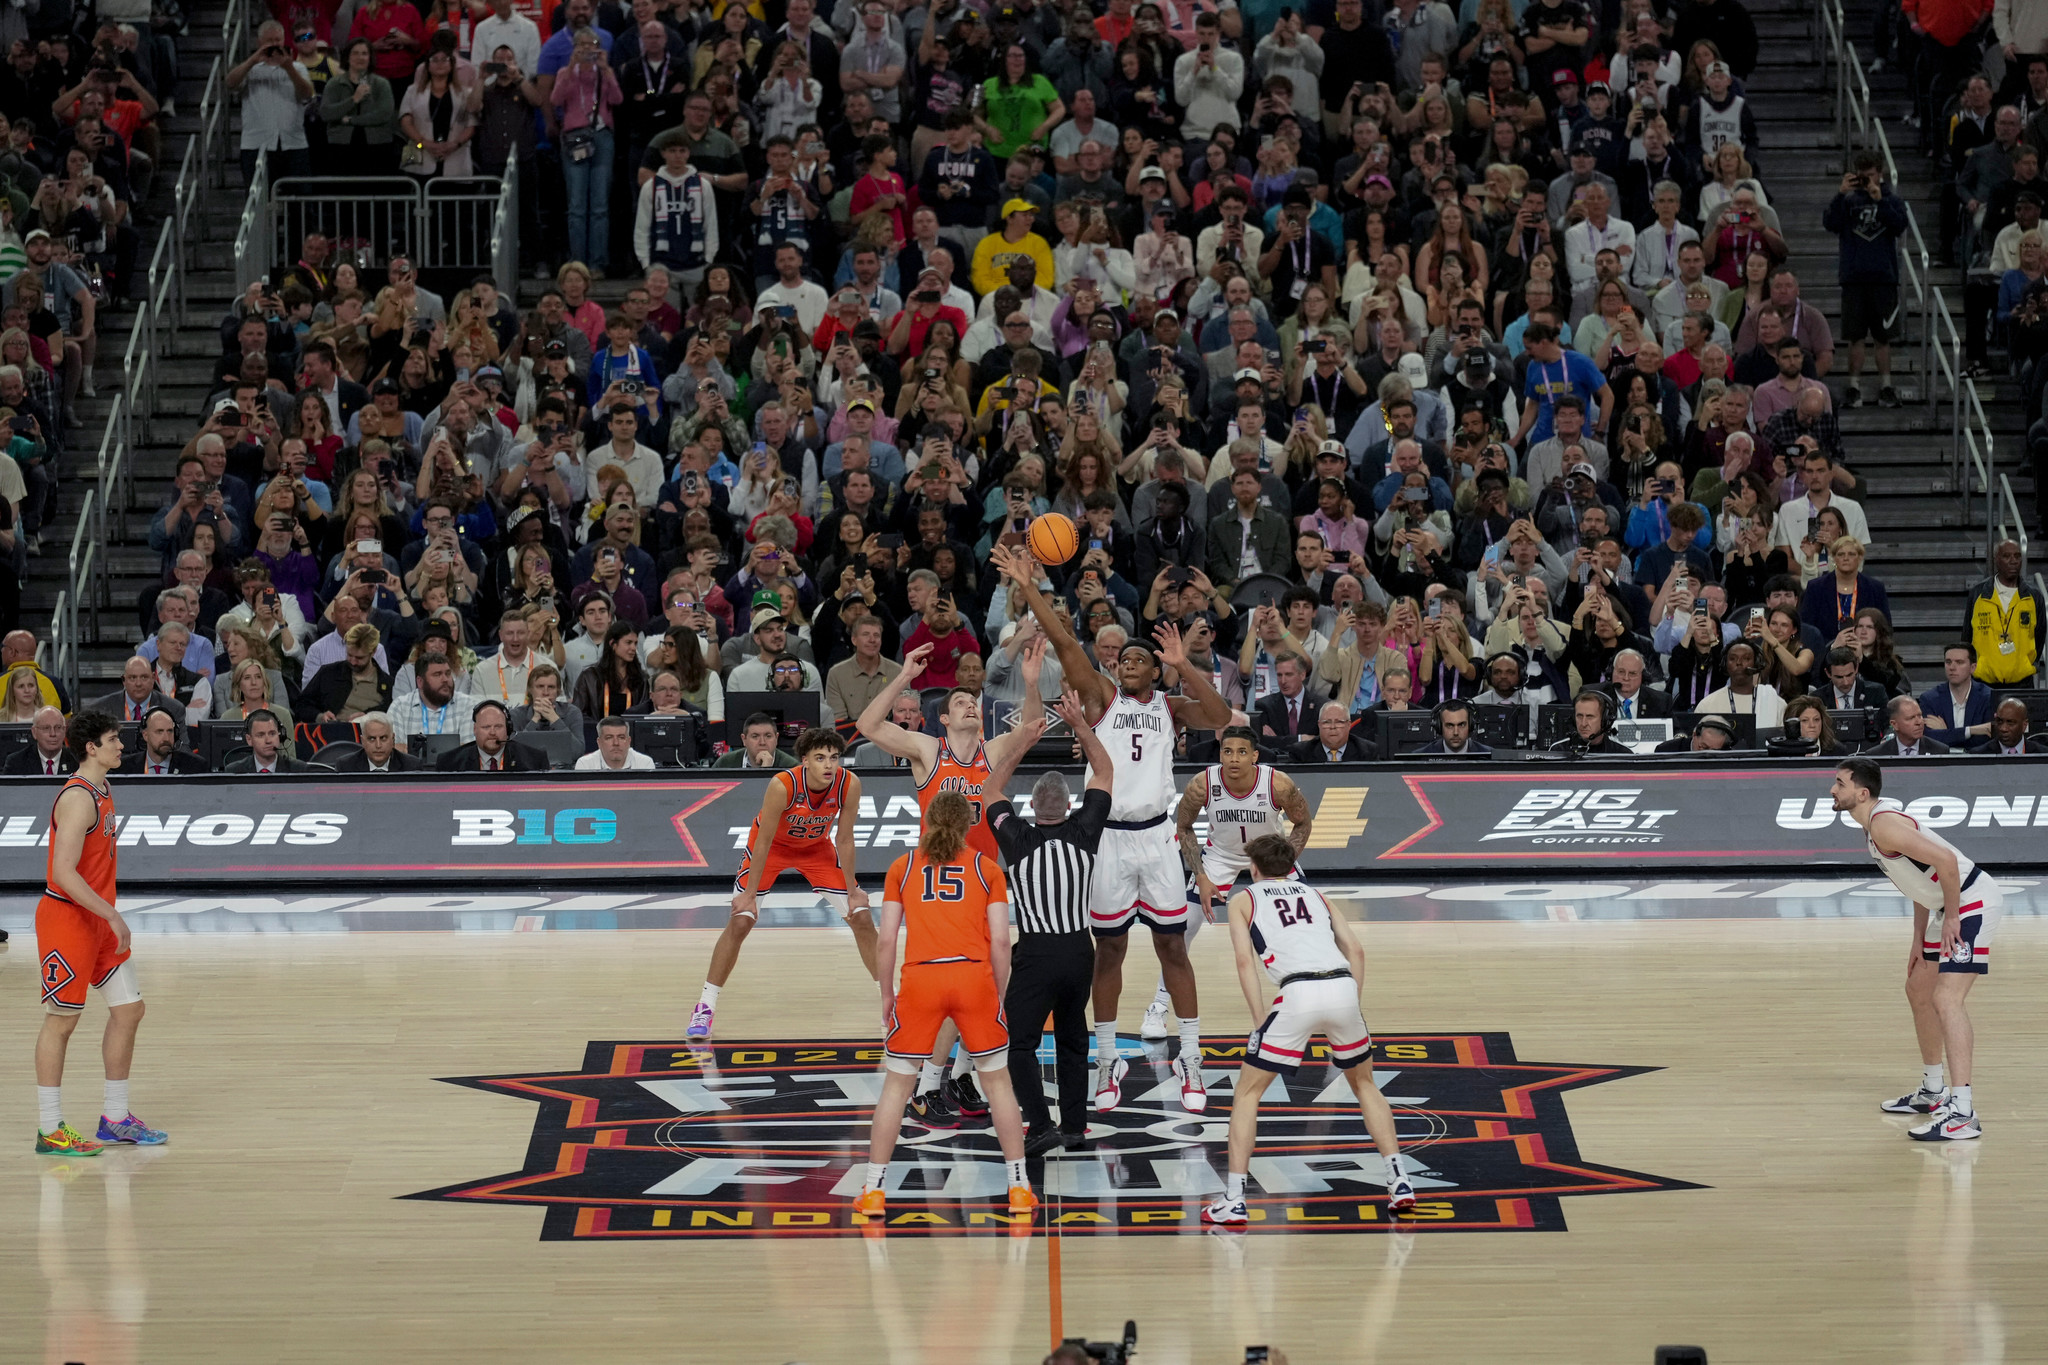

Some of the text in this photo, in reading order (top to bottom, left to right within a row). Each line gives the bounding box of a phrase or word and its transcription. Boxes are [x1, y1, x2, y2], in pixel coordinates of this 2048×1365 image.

[938, 162, 975, 178] UCONN
[776, 209, 786, 229] 5
[1113, 713, 1161, 733] CONNCTICUT
[1131, 734, 1143, 761] 5
[937, 776, 985, 796] Illino
[1512, 789, 1643, 810] BIG
[969, 800, 982, 826] 3
[1215, 809, 1266, 823] CONNECTICUT
[1493, 811, 1677, 830] EAST
[451, 808, 617, 845] B1G
[787, 824, 828, 840] 23
[1239, 825, 1247, 844] 1
[1531, 837, 1663, 845] CONFERENCE
[922, 866, 965, 902] 15
[1263, 886, 1307, 897] MULLINS
[1274, 896, 1313, 928] 24
[670, 1050, 886, 1068] 2026
[642, 1152, 1459, 1198] FOUR
